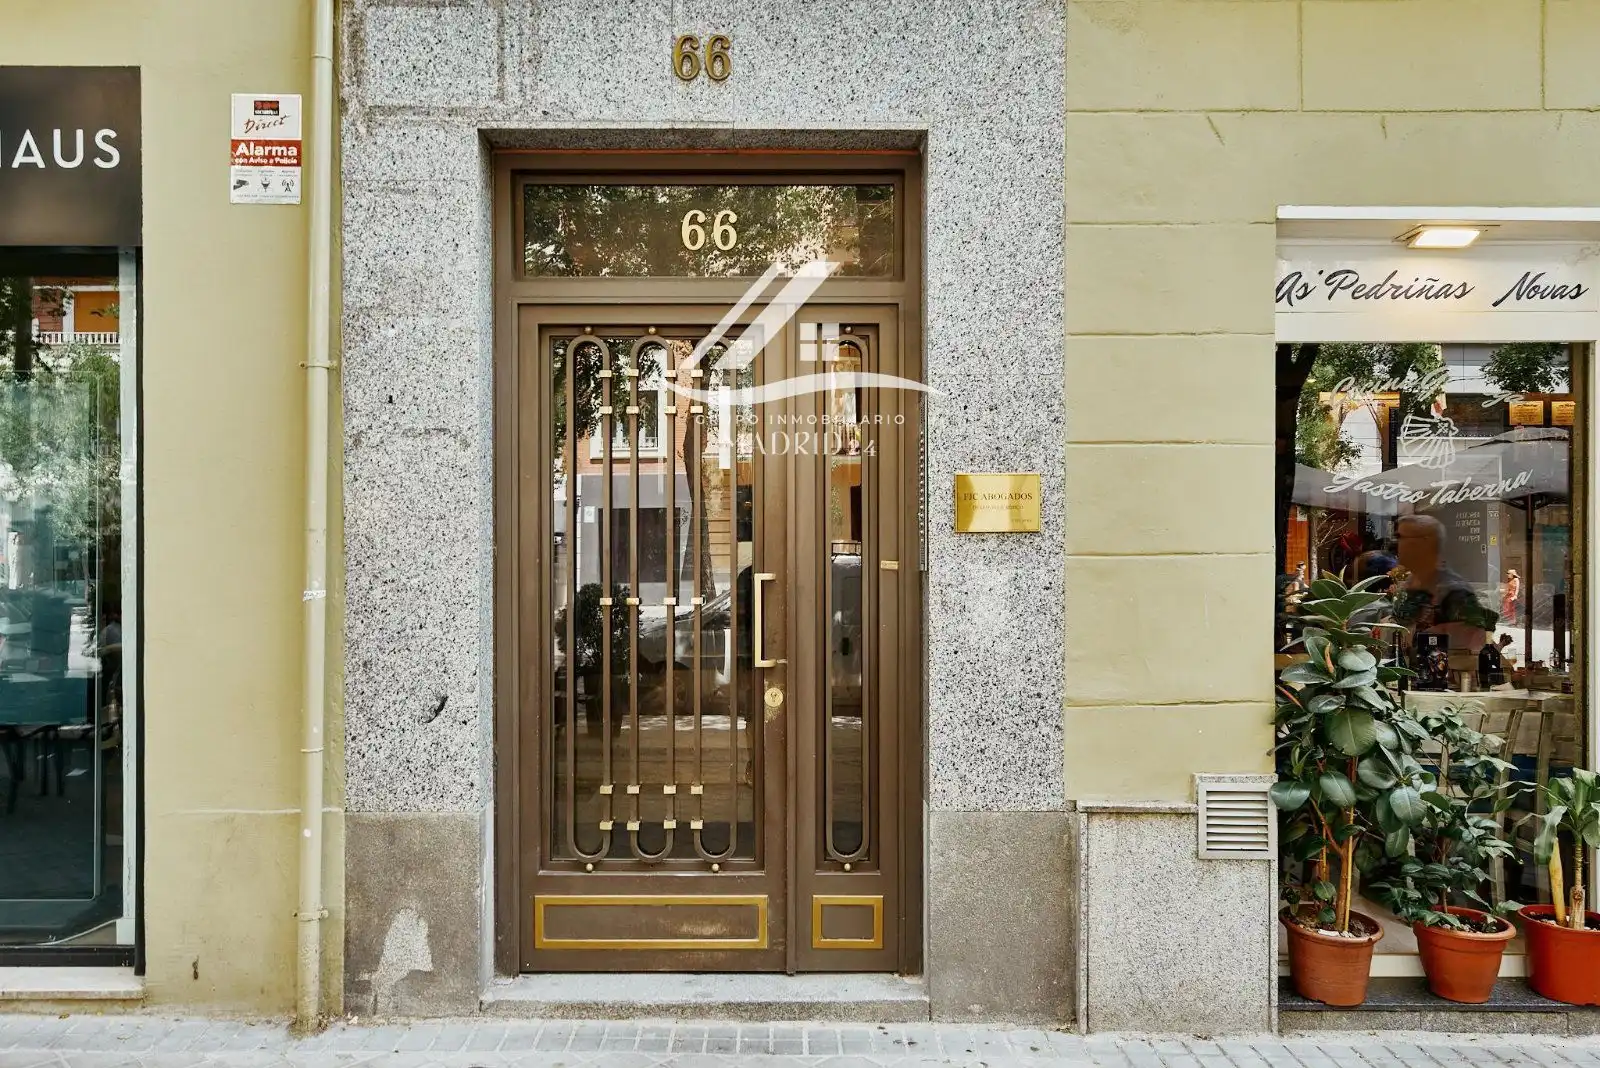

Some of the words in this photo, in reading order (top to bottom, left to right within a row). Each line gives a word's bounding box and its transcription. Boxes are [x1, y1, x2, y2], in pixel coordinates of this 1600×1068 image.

[673, 34, 732, 81] 66
[0, 128, 121, 169] AUS
[235, 142, 298, 156] Alarma
[682, 209, 738, 251] 66
[1324, 268, 1476, 301] Pedriñas
[1491, 271, 1590, 308] Novas
[981, 492, 1033, 501] ABOGADOS
[1323, 472, 1431, 503] Gastro
[1428, 468, 1533, 506] Taberna
